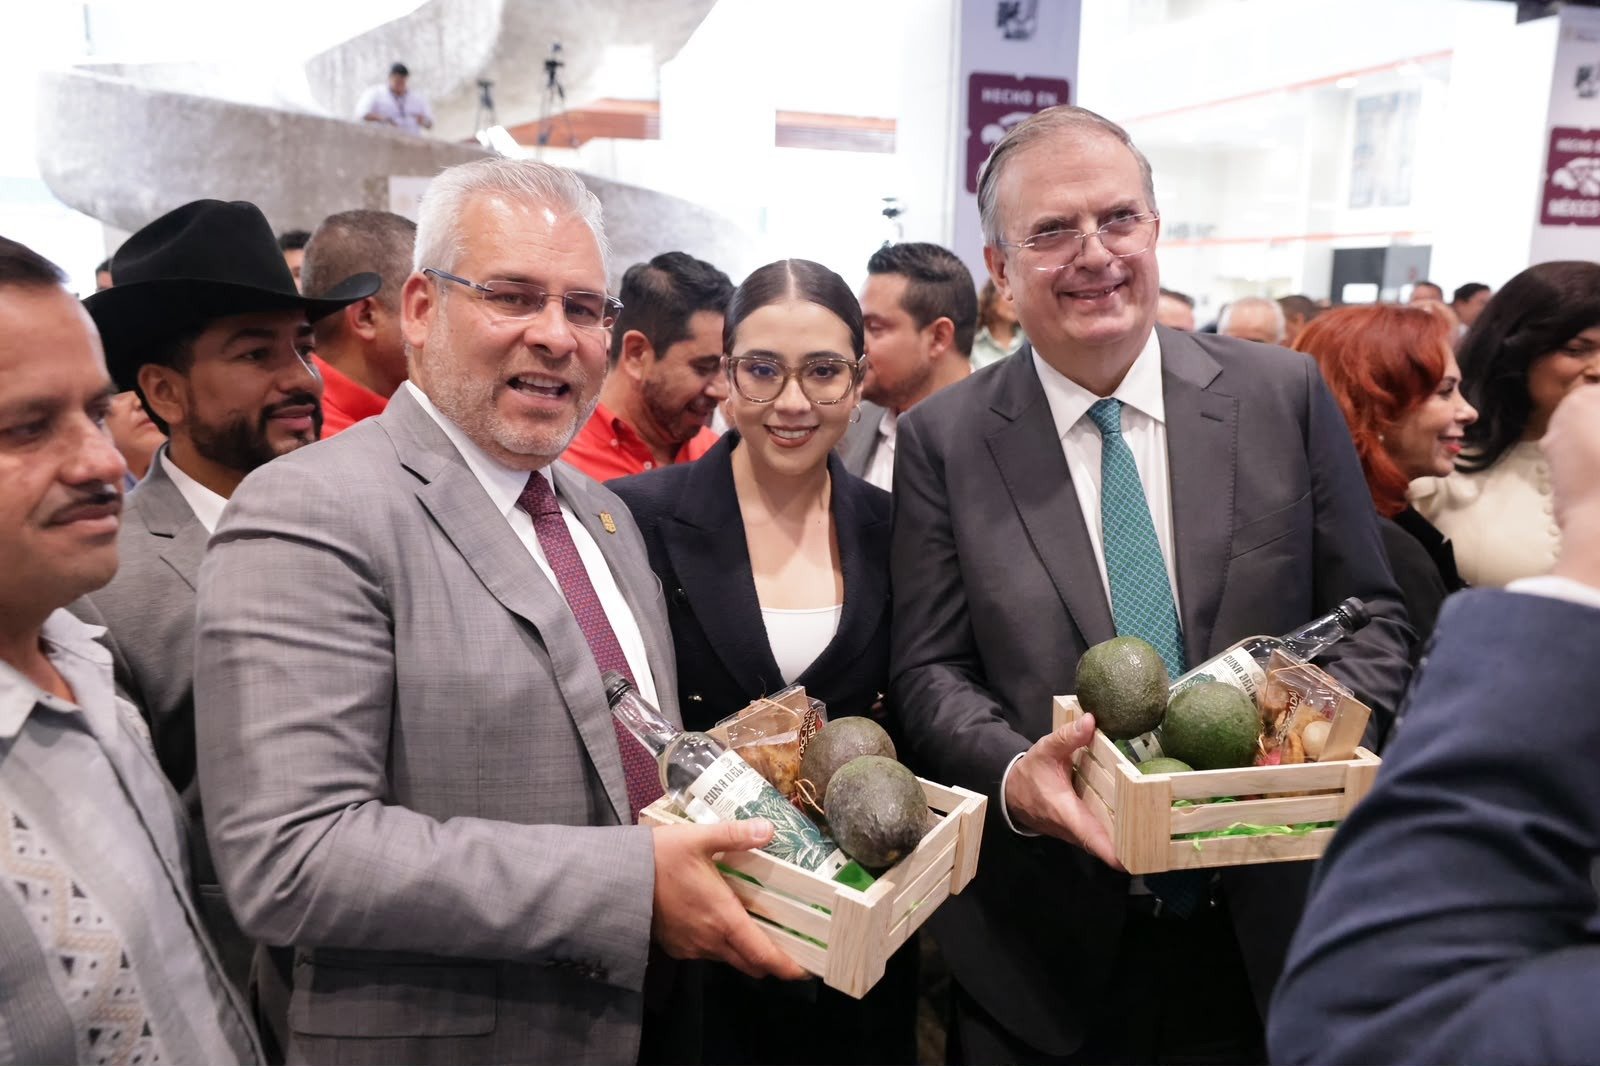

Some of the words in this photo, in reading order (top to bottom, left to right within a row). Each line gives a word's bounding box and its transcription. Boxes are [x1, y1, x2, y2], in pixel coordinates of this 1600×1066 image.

[981, 87, 1034, 105] HECHO
[1036, 91, 1058, 106] EN
[1223, 654, 1244, 675] CUNA
[1239, 673, 1255, 693] DEL
[703, 778, 729, 806] CUNA
[724, 766, 744, 783] DEL
